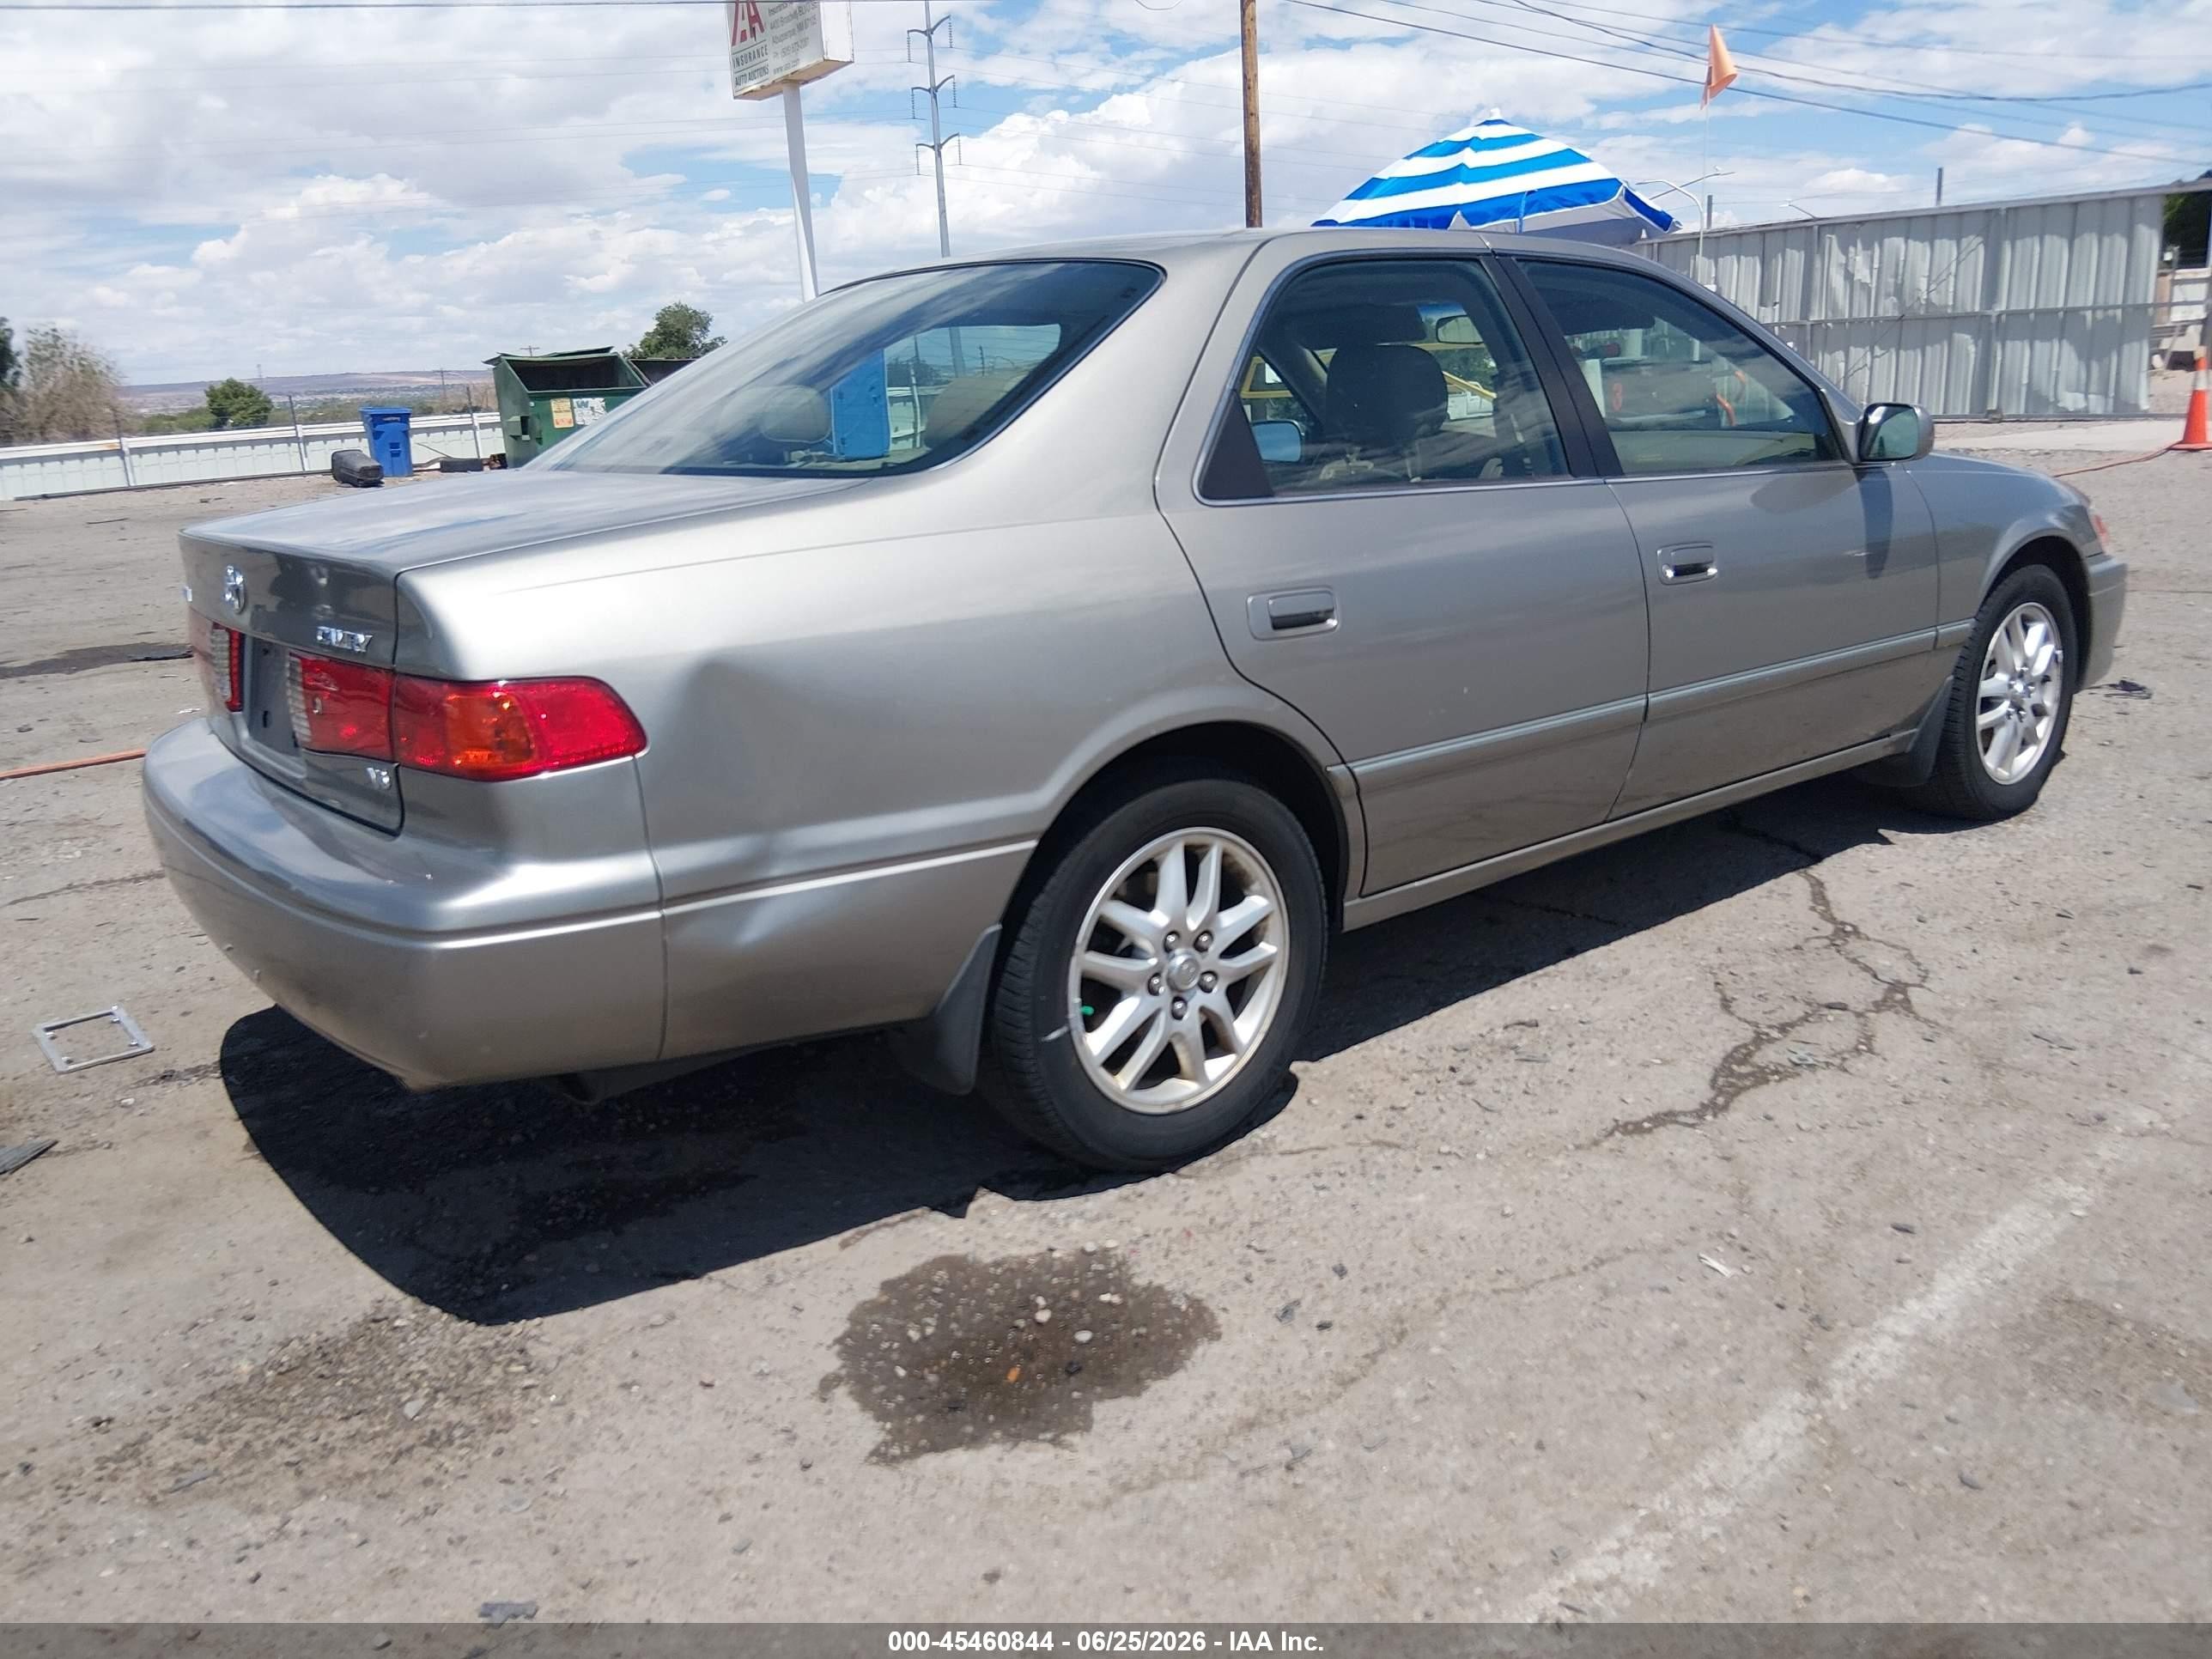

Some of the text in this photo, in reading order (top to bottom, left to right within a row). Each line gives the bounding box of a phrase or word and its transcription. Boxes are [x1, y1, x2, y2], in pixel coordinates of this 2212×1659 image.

[732, 45, 769, 69] INSURANCE
[735, 73, 747, 87] AUTO
[748, 64, 769, 82] AUCTIONS
